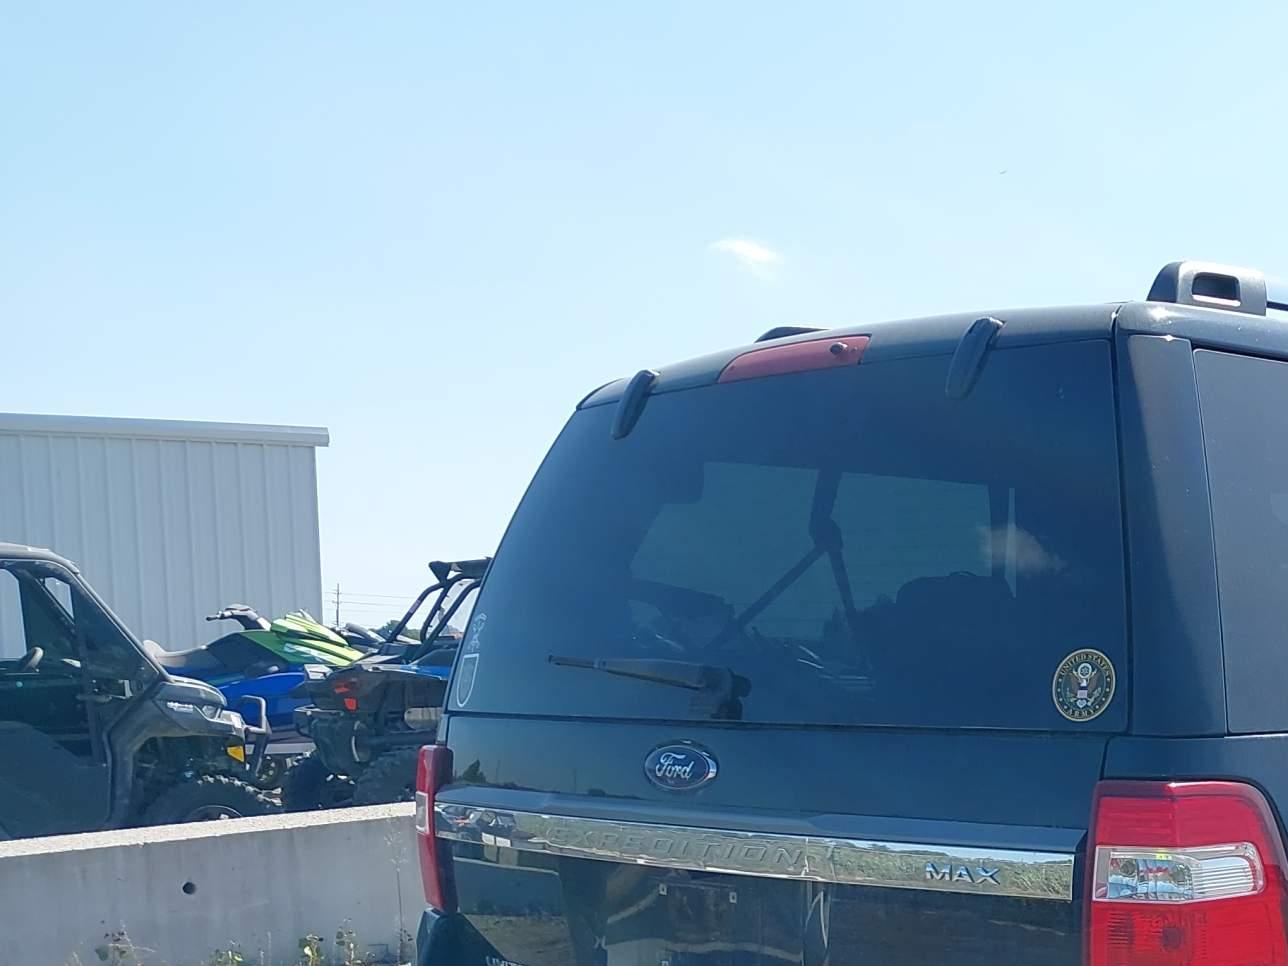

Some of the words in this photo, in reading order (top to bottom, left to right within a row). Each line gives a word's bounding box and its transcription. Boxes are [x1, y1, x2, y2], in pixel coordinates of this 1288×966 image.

[655, 752, 695, 780] Ford
[547, 825, 806, 866] EXPEDITION
[926, 862, 1001, 885] MAX
